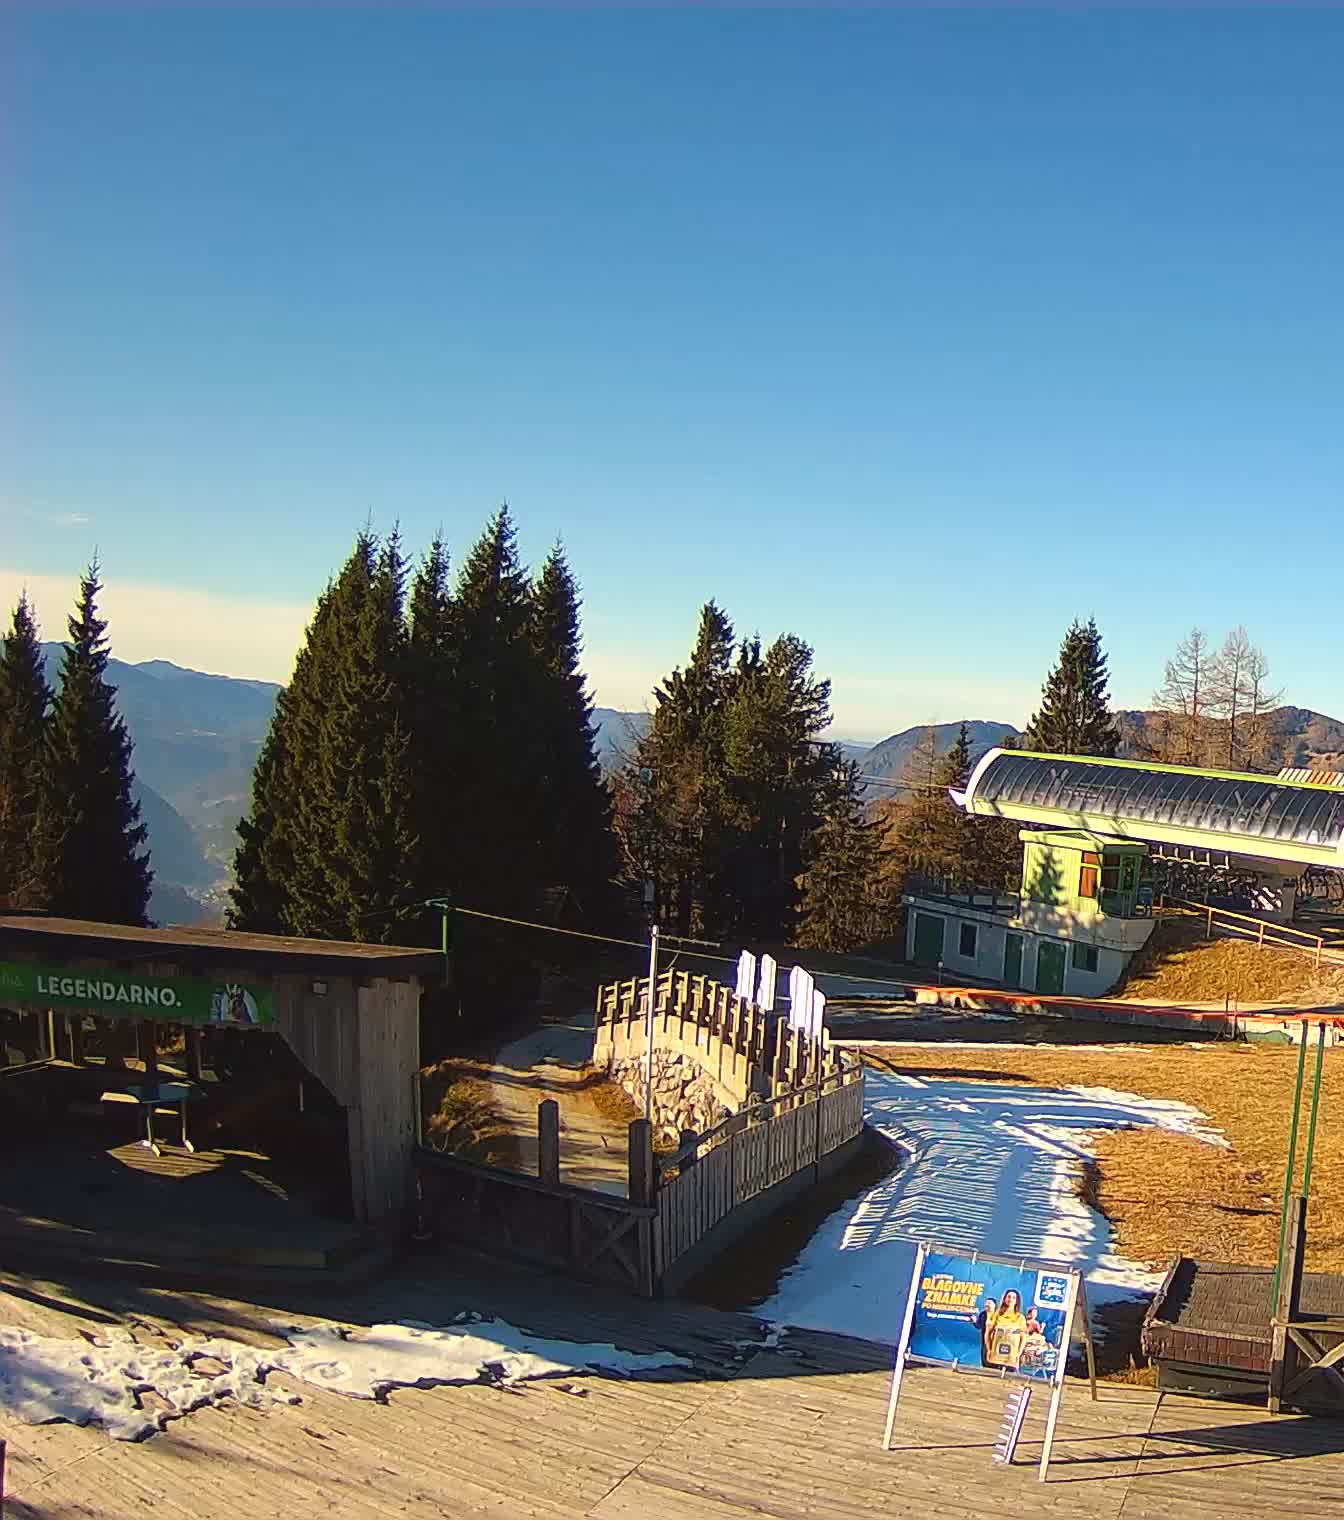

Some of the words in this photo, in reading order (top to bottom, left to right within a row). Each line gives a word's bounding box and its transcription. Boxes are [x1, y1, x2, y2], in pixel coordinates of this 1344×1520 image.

[36, 975, 182, 1007] LEGENDARNO.
[921, 1277, 985, 1296] BLAGOVNE
[924, 1291, 977, 1307] ZNAMKE
